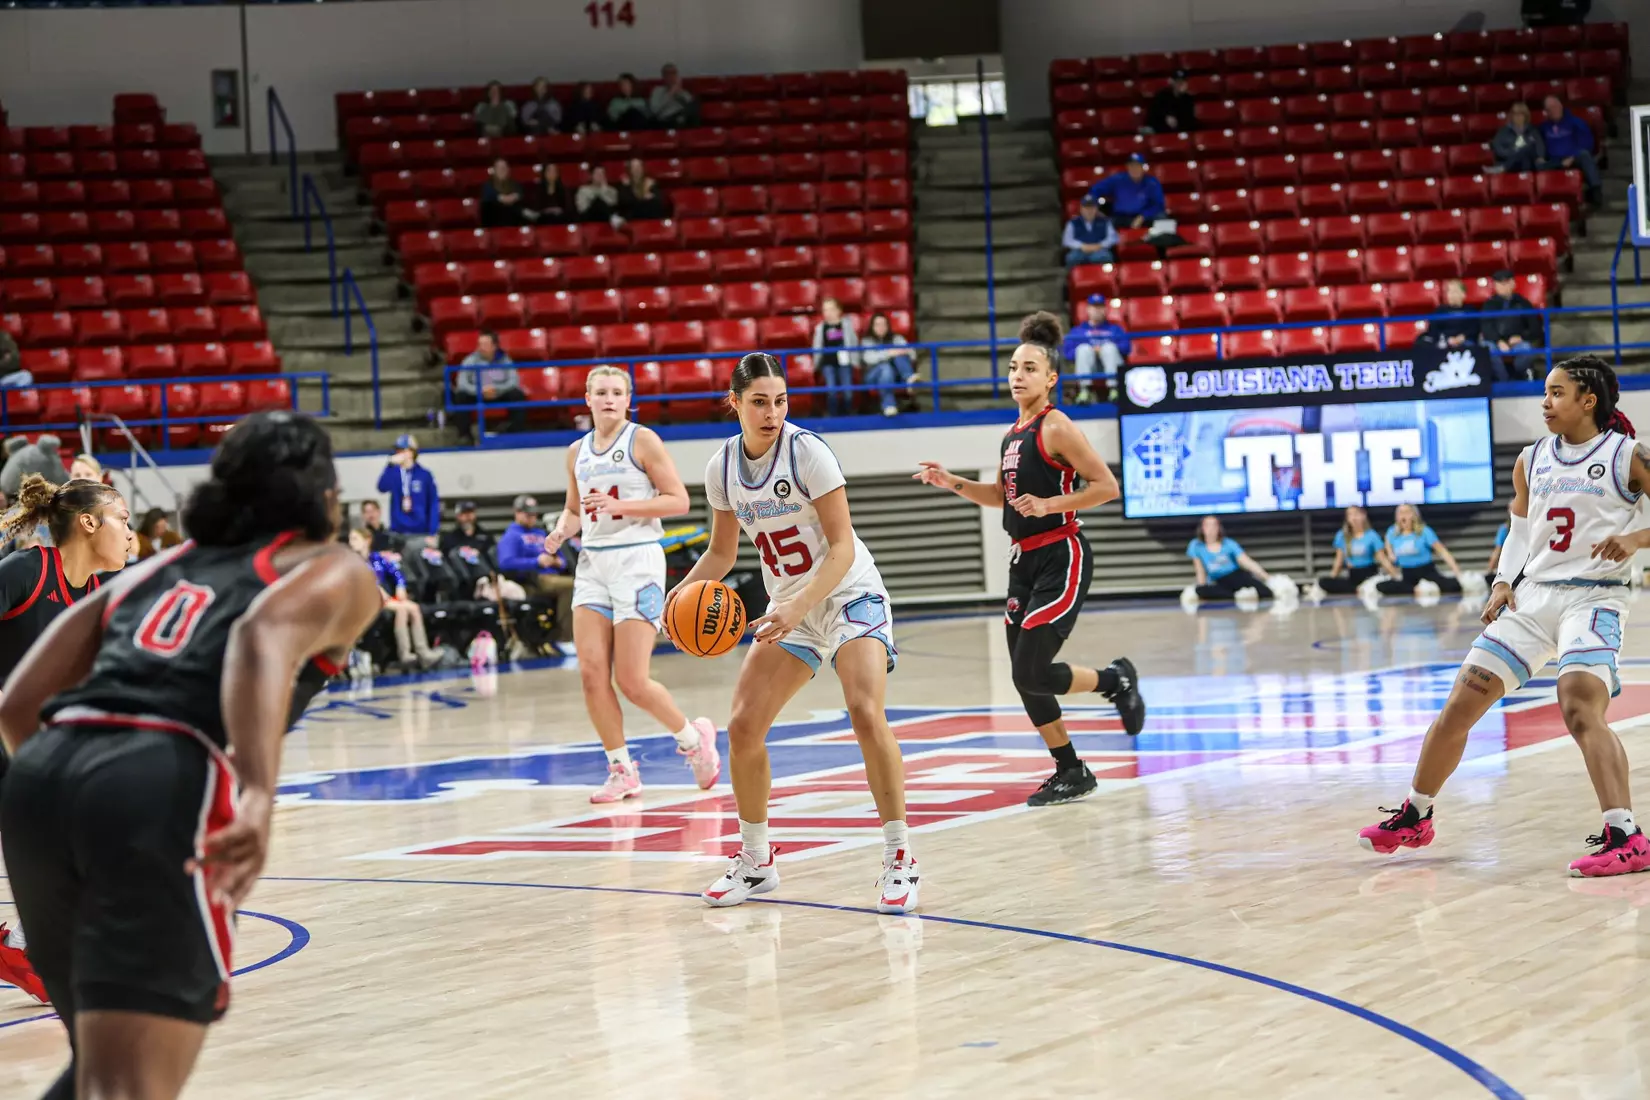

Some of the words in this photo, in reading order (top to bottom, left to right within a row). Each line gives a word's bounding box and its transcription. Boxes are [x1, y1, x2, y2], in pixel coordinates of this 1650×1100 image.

[584, 0, 637, 29] 114
[1174, 364, 1333, 399] LOUISIANA
[1333, 360, 1414, 391] TECH
[1224, 428, 1425, 511] THE
[755, 525, 813, 577] 45
[1546, 507, 1575, 552] 3
[133, 579, 216, 658] 0
[702, 588, 723, 635] Wilson
[728, 597, 742, 637] NCAA
